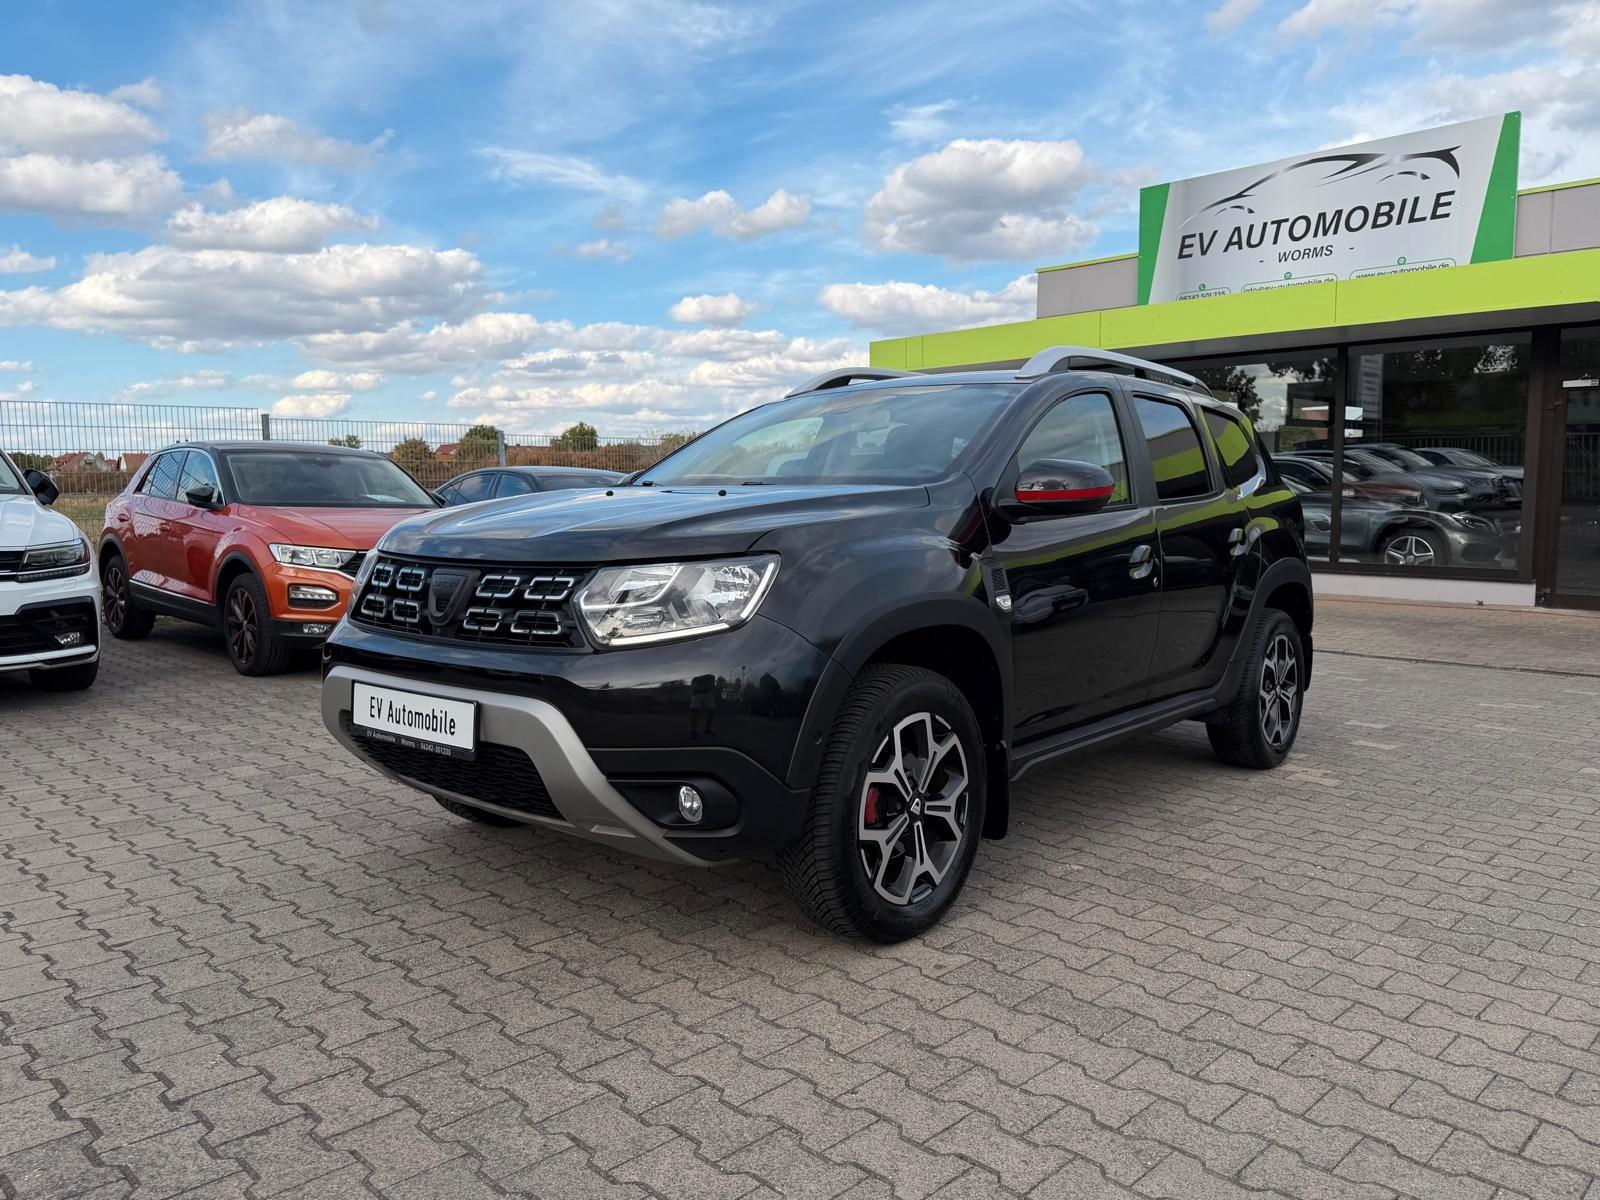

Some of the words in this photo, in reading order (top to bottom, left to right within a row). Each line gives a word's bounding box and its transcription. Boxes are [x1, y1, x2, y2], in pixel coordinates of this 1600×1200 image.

[1177, 229, 1219, 260] EV
[1222, 190, 1456, 253] AUTOMOBILE
[1278, 244, 1334, 264] WORMS
[1355, 263, 1450, 278] wwwev-automobilede
[1243, 277, 1335, 293] info@ev-automobilede
[370, 697, 383, 718] EV
[387, 700, 456, 736] Automobile
